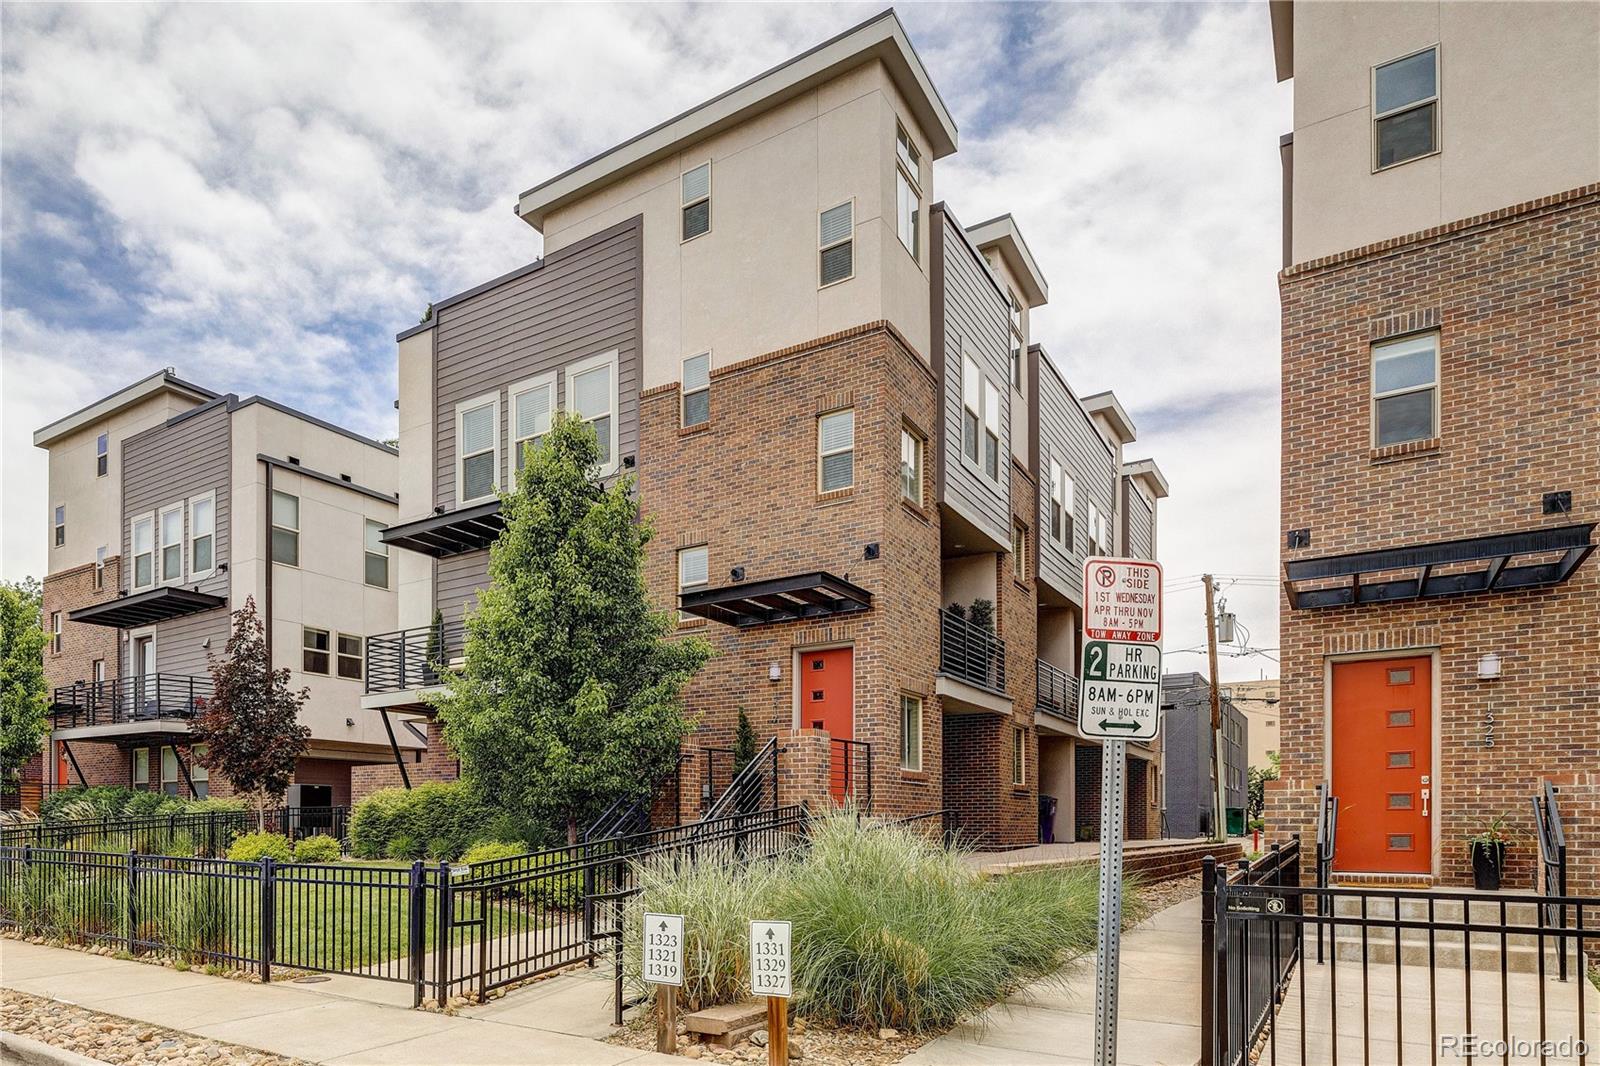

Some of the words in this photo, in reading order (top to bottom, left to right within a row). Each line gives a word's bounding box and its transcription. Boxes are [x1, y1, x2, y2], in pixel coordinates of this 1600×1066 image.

[1127, 567, 1150, 579] THIS
[1126, 578, 1149, 590] SIDE
[1095, 591, 1110, 603] 1ST
[1115, 592, 1156, 604] WEDNESDAY
[1094, 605, 1111, 616] APR
[1114, 606, 1135, 617] THRU
[1137, 607, 1154, 618] NOV
[1091, 629, 1107, 639] TOW
[1111, 630, 1131, 640] AWAY
[1136, 631, 1156, 642] ZONE
[1089, 646, 1103, 677] 2
[1125, 647, 1143, 663] HR
[1109, 663, 1157, 680] PARKING
[1091, 706, 1106, 715] SUN
[1108, 707, 1114, 716] &
[1118, 707, 1133, 717] HOL
[1136, 708, 1150, 718] EXC
[649, 933, 678, 948] 1323
[649, 948, 677, 963] 1321
[756, 942, 785, 956] 1331
[649, 963, 677, 978] 1319
[757, 958, 786, 973] 1329
[757, 974, 786, 989] 1327
